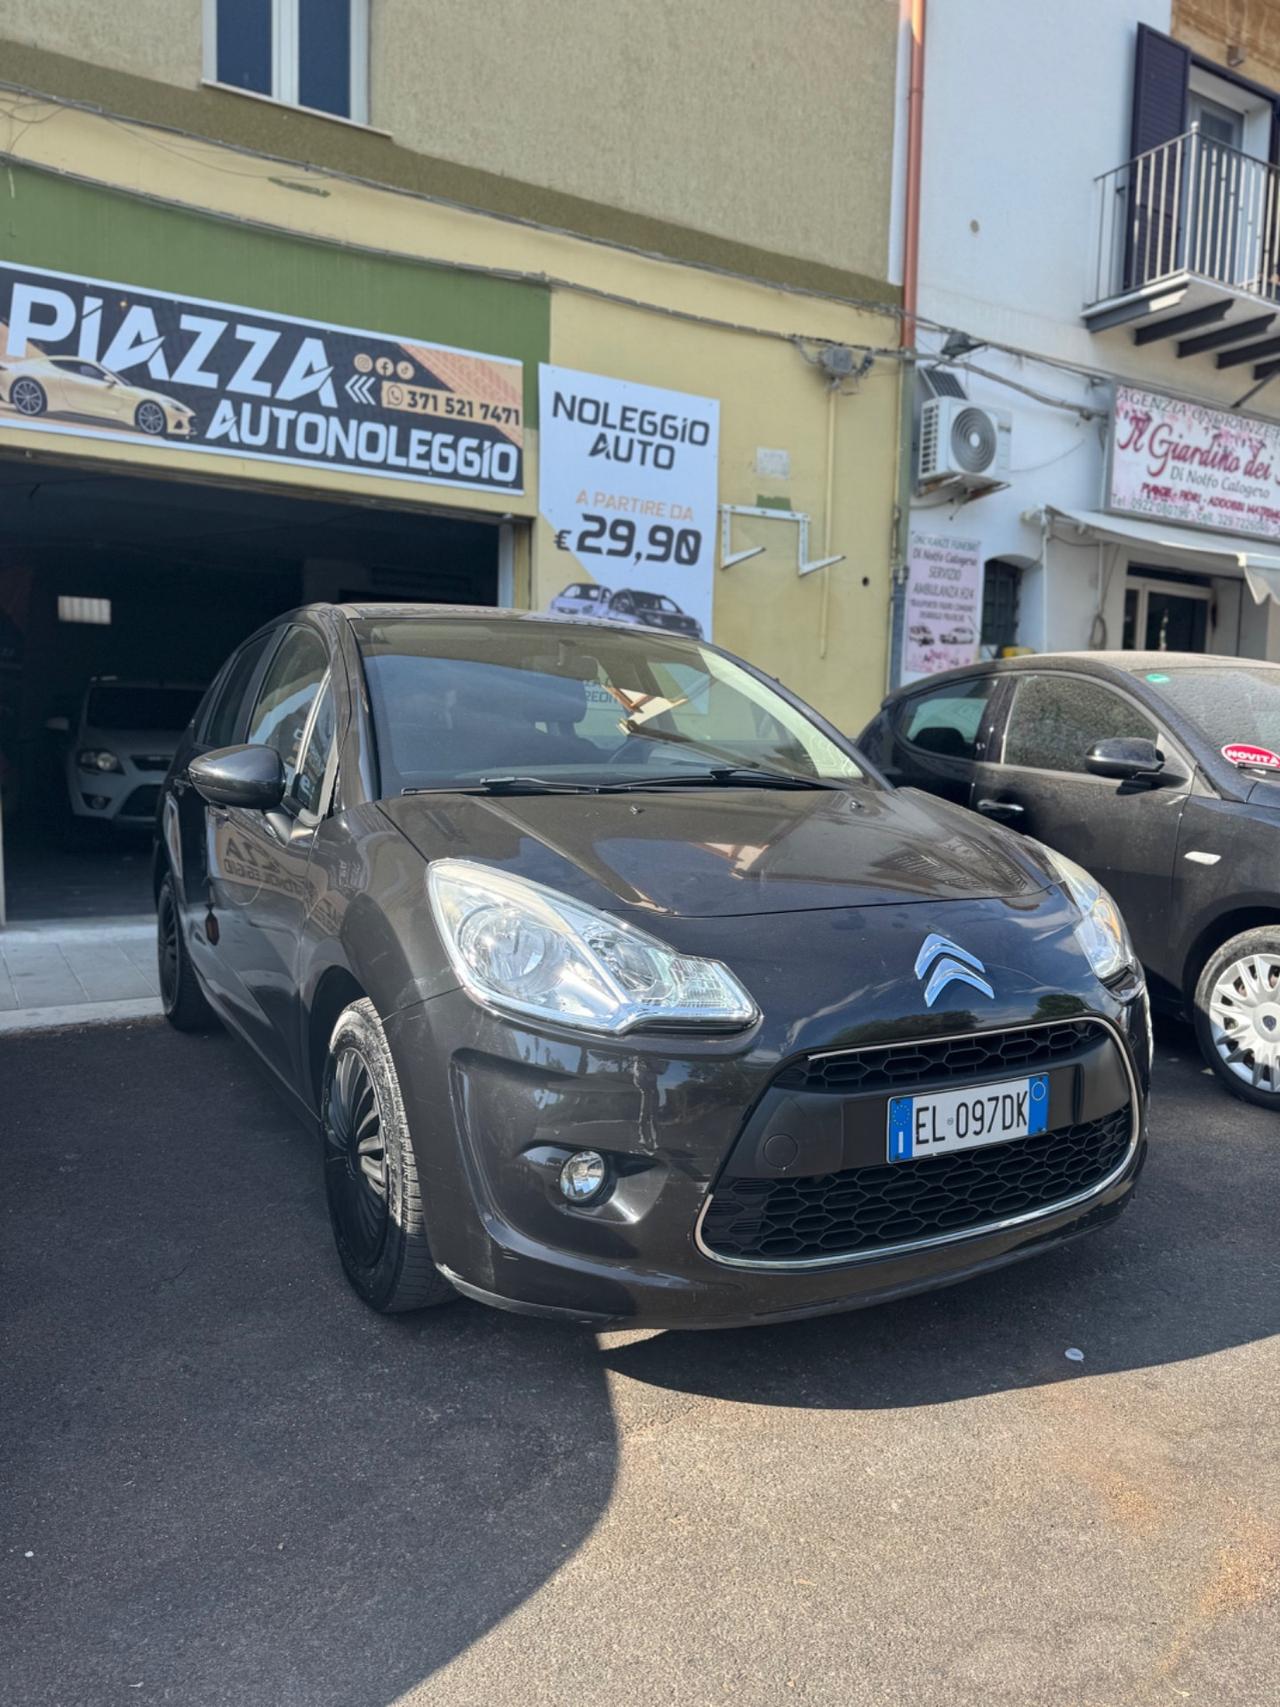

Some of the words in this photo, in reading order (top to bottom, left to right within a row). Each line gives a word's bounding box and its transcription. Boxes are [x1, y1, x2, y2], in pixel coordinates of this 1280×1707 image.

[407, 390, 438, 412] 371
[445, 398, 474, 417] 521
[479, 403, 520, 426] 7471
[1117, 388, 1187, 418] AGENZIA
[588, 432, 675, 471] AUTO
[1147, 423, 1240, 478] Giardino
[1170, 466, 1185, 482] Di
[1186, 468, 1219, 489] Nolfo
[575, 489, 589, 505] A
[669, 503, 694, 521] DA
[915, 1105, 946, 1145] EL
[956, 1090, 1028, 1139] 097DK
